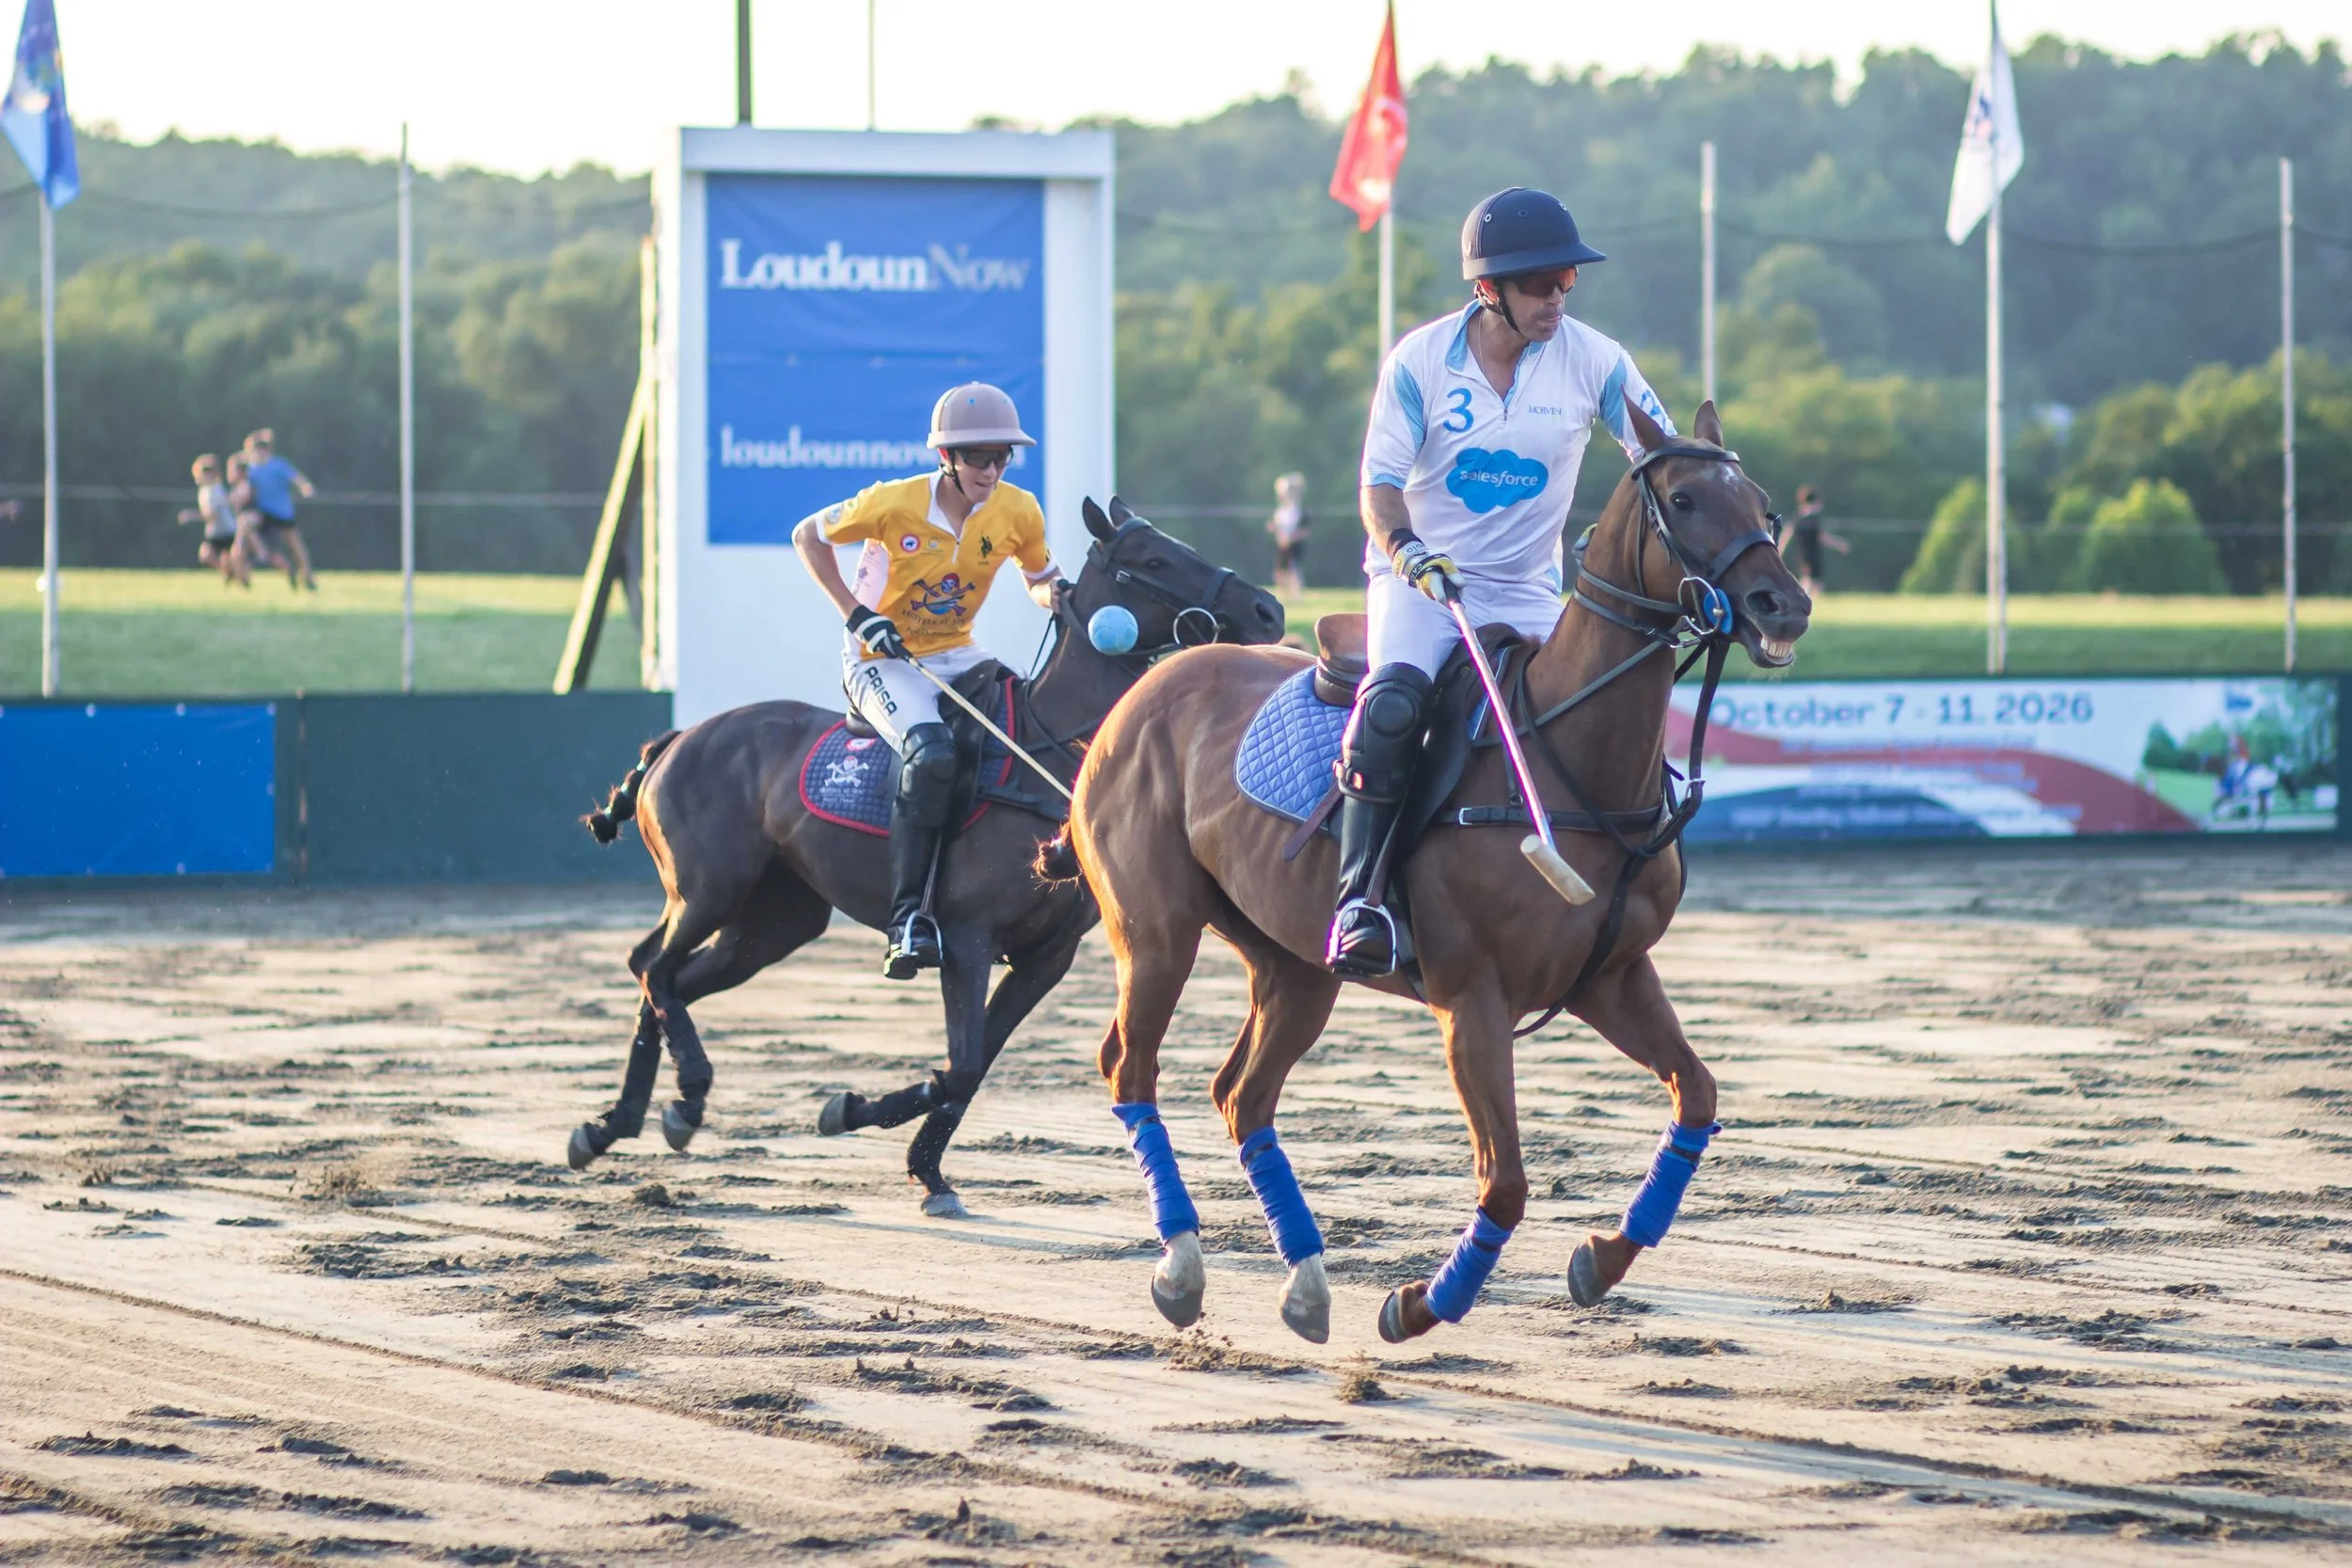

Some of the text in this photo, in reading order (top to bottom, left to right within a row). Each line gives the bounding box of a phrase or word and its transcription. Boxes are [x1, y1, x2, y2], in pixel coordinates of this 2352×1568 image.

[721, 239, 1029, 291] LoudounNow
[1443, 388, 1474, 433] 3
[1528, 405, 1562, 415] MORVEN
[1460, 469, 1538, 488] salesforce
[865, 666, 898, 717] PRISA
[1708, 694, 1873, 727] October
[1885, 694, 1906, 724] 7
[1994, 691, 2094, 724] 2026
